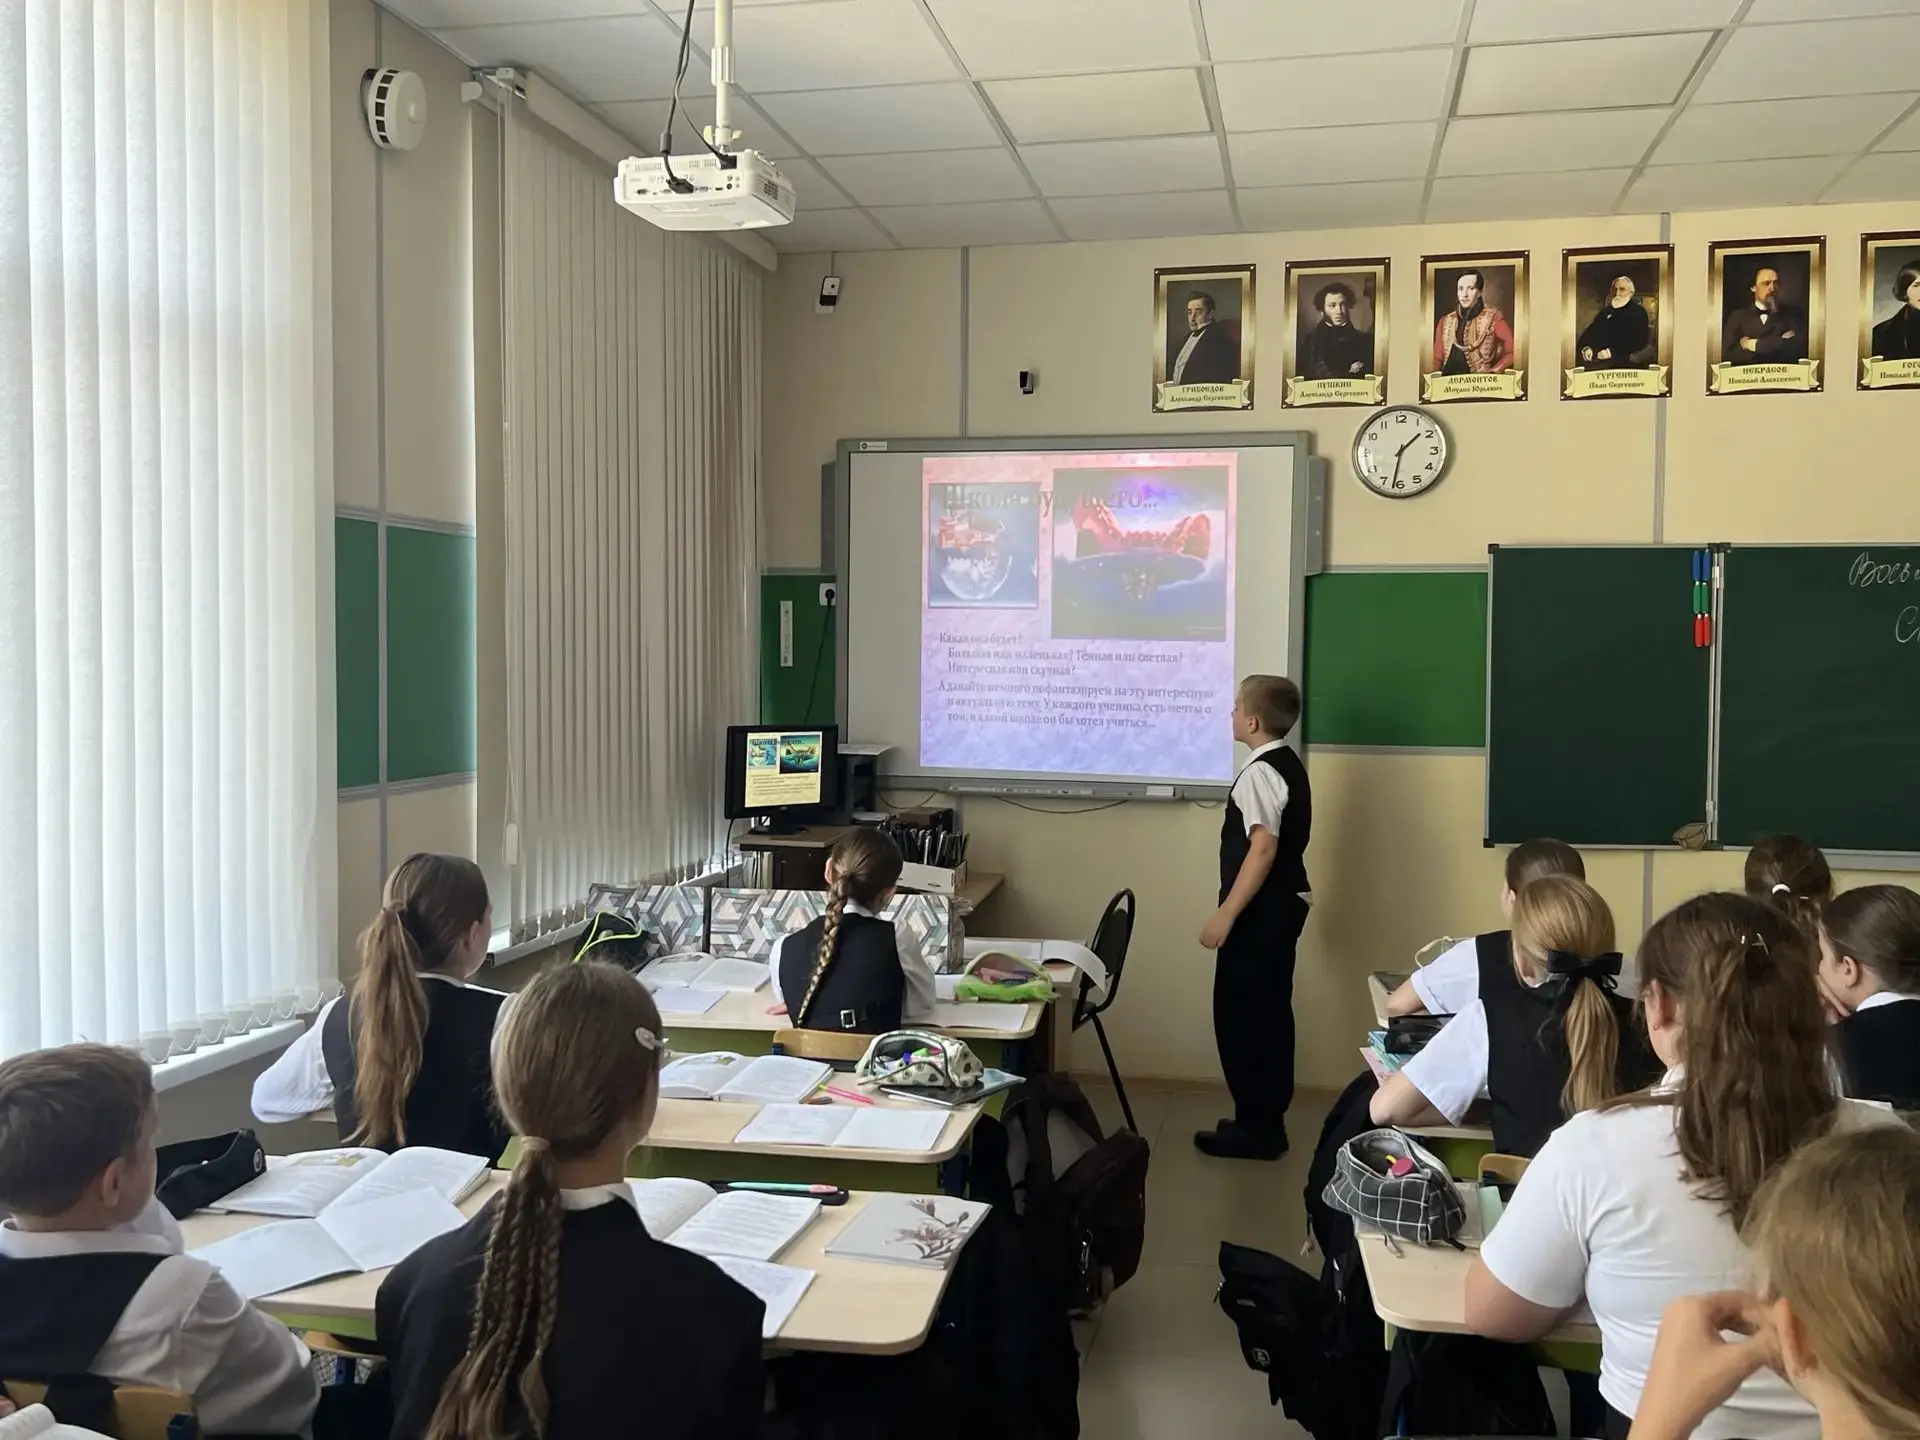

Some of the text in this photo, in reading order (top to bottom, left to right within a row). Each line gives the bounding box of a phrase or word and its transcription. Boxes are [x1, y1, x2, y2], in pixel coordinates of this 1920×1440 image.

[1742, 366, 1788, 375] НЕКРАСОВ
[1448, 375, 1498, 385] ЛЕРМОНТОВ
[1596, 371, 1639, 380] ТУРГЕНЕВ
[1728, 376, 1758, 384] Николай
[1317, 381, 1352, 389] ПУШКИН
[1589, 381, 1607, 389] Иван
[1182, 386, 1224, 394] ГРИБОЕДОВ
[1299, 389, 1369, 399] Александр Сергеевич
[1395, 415, 1407, 424] 12
[1380, 421, 1388, 430] 11
[1368, 432, 1378, 441] 10
[1424, 429, 1434, 439] 2
[1429, 446, 1439, 455] 3
[1424, 462, 1433, 471] 4
[1379, 476, 1388, 486] 7
[1412, 475, 1422, 484] 5
[1395, 480, 1405, 489] 6
[1114, 686, 1127, 696] на
[1043, 697, 1051, 709] У
[1052, 700, 1096, 711] каждого
[1142, 704, 1166, 714] есть
[1205, 706, 1212, 714] о
[1043, 715, 1056, 725] он
[1058, 712, 1073, 725] бы
[1075, 717, 1104, 727] хотел
